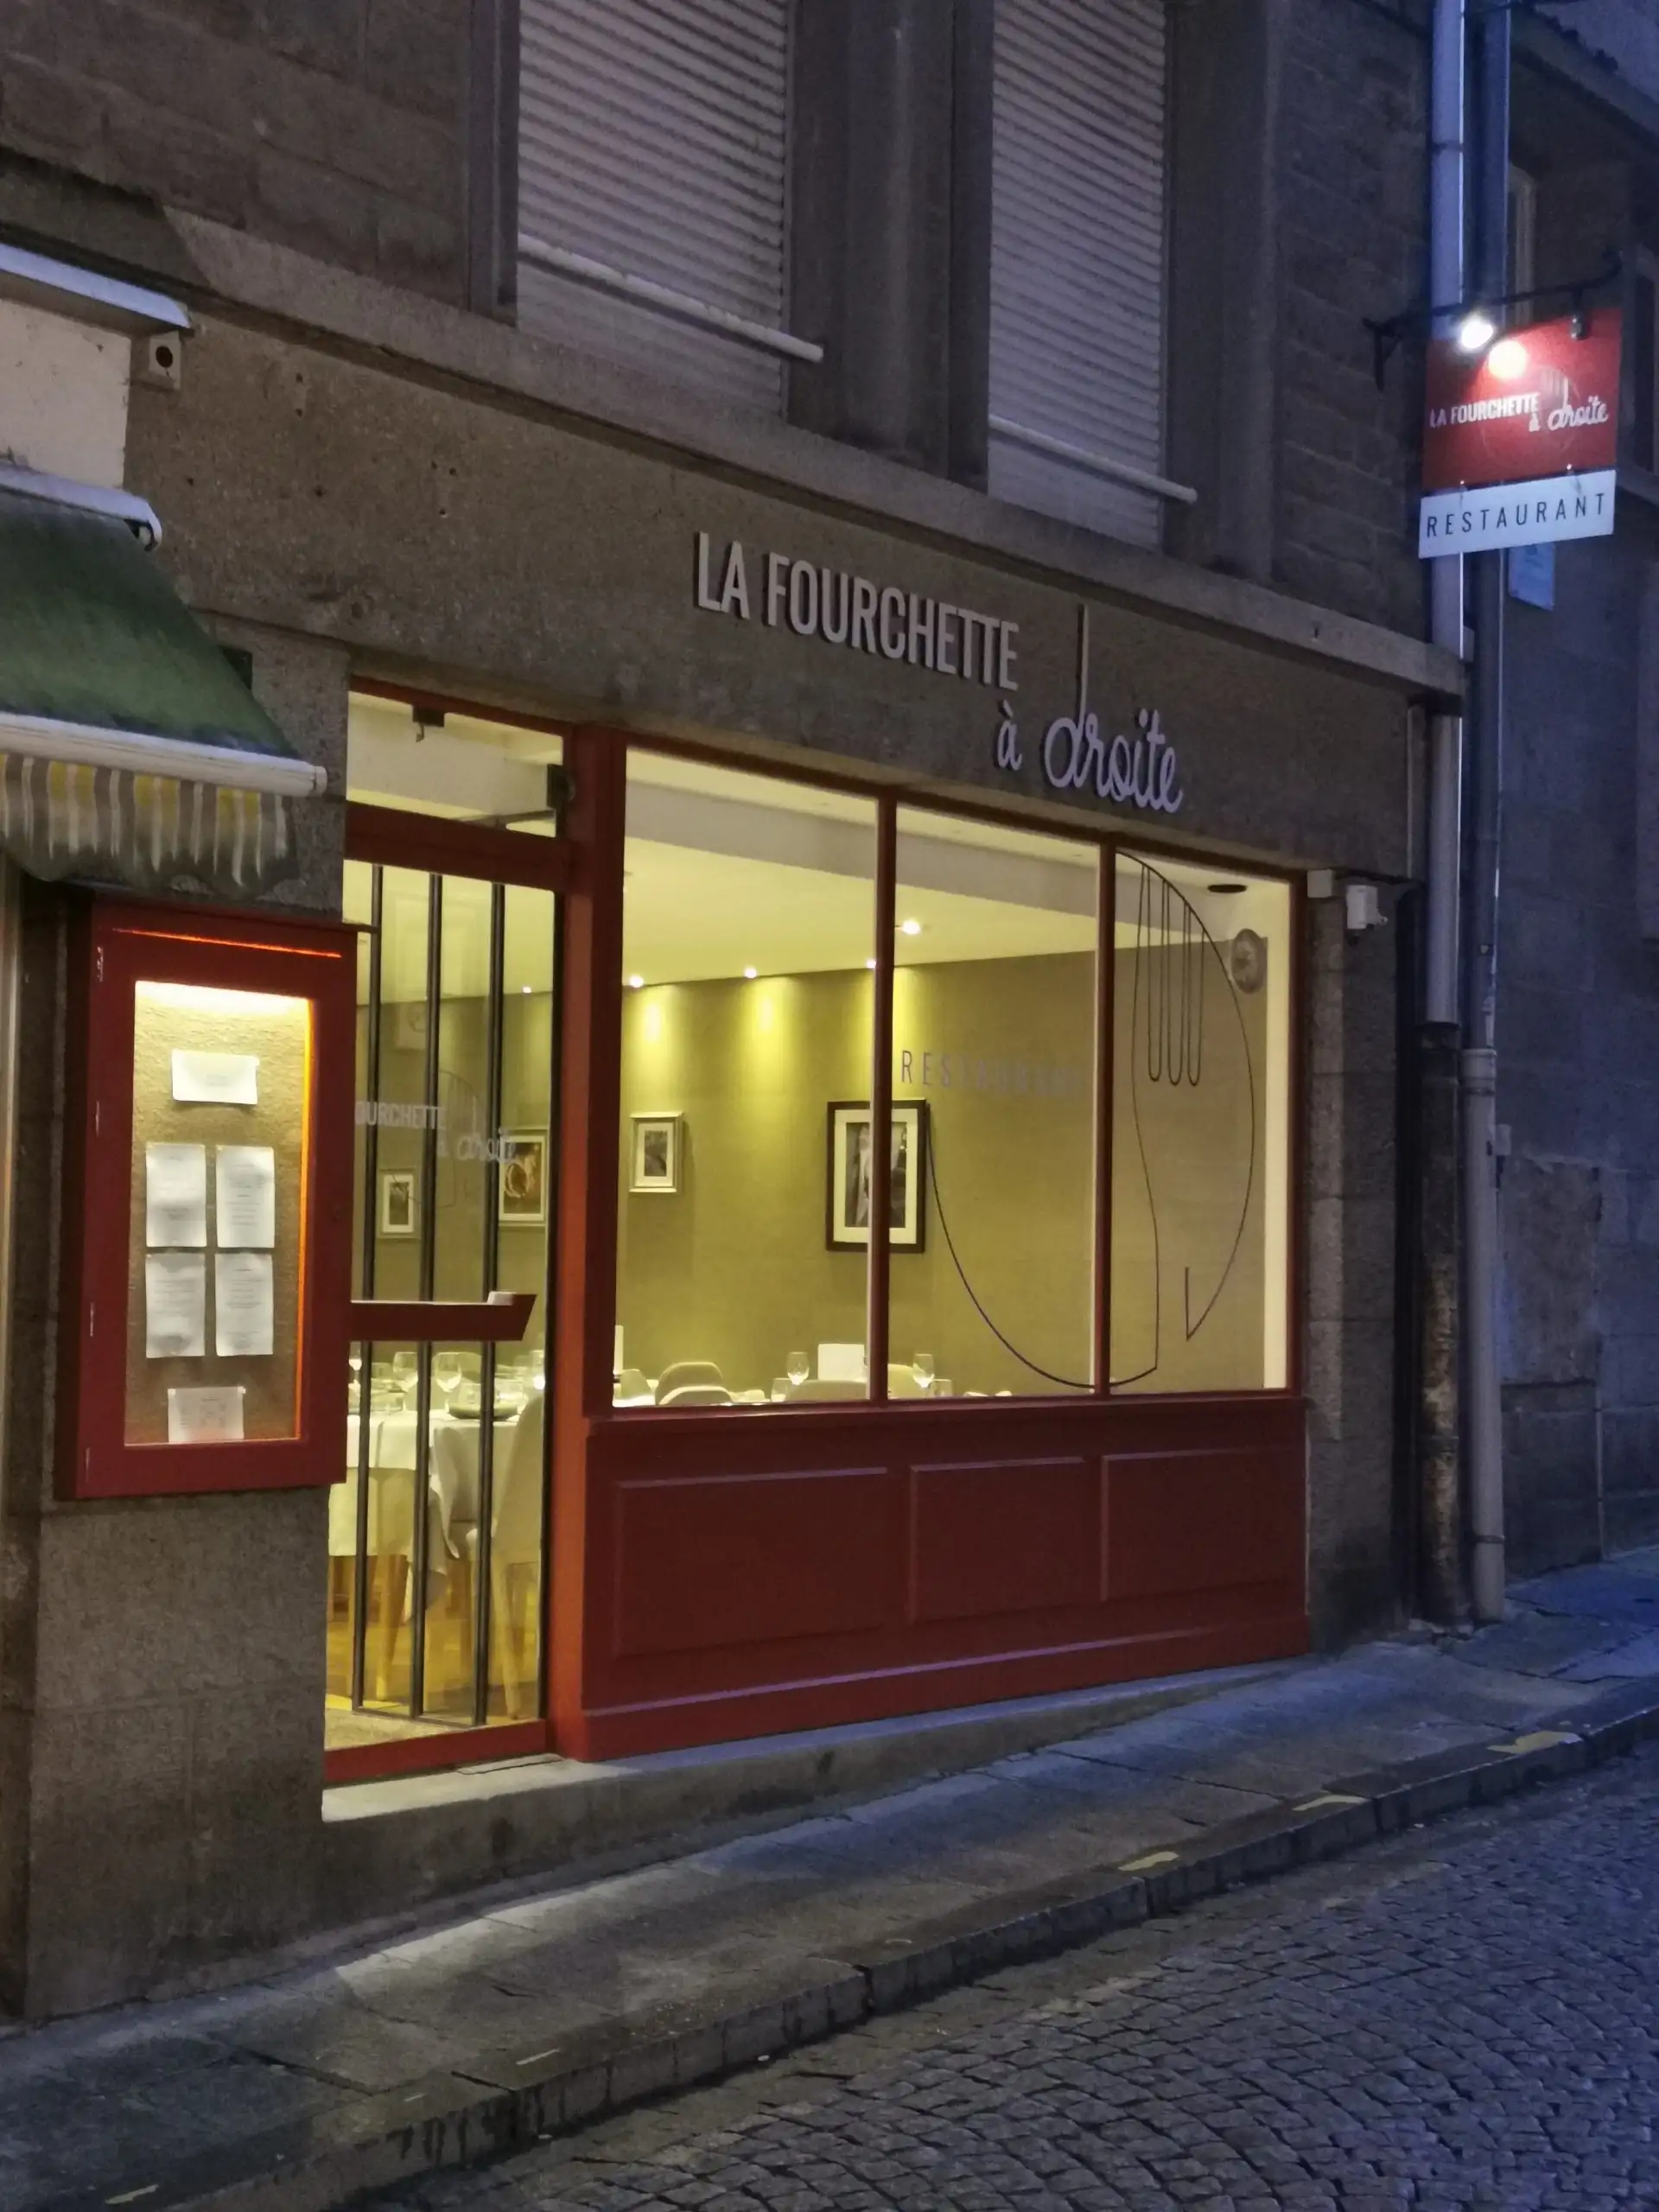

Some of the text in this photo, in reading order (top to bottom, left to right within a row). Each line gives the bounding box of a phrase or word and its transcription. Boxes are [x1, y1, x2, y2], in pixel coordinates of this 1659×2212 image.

[1430, 392, 1540, 428] LA FOURCHETTE
[1548, 377, 1609, 430] droite
[1427, 493, 1605, 538] RESTAURANT
[696, 531, 1020, 691] LA FOURCHETTE
[996, 604, 1185, 814] à droite
[901, 1050, 1082, 1096] RESTAUR
[355, 1101, 447, 1130] OURCHETTE
